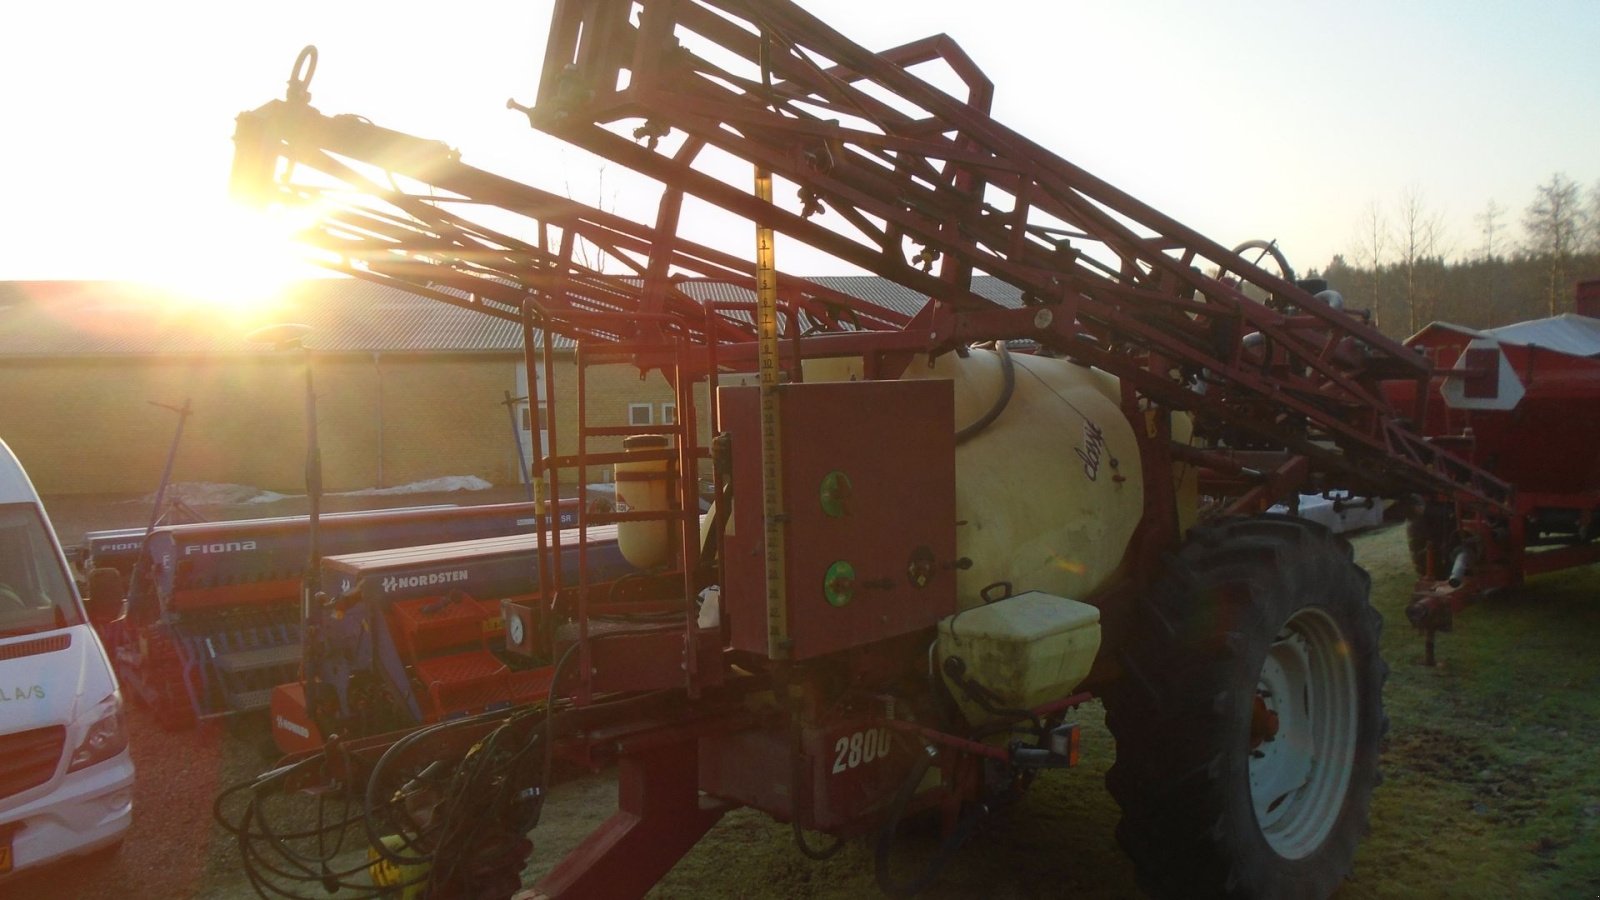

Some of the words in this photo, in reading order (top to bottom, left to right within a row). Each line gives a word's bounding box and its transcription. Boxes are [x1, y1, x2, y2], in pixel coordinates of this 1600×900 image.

[398, 569, 469, 589] NORDSTEN
[15, 684, 46, 700] A/S
[832, 727, 891, 775] 2800
